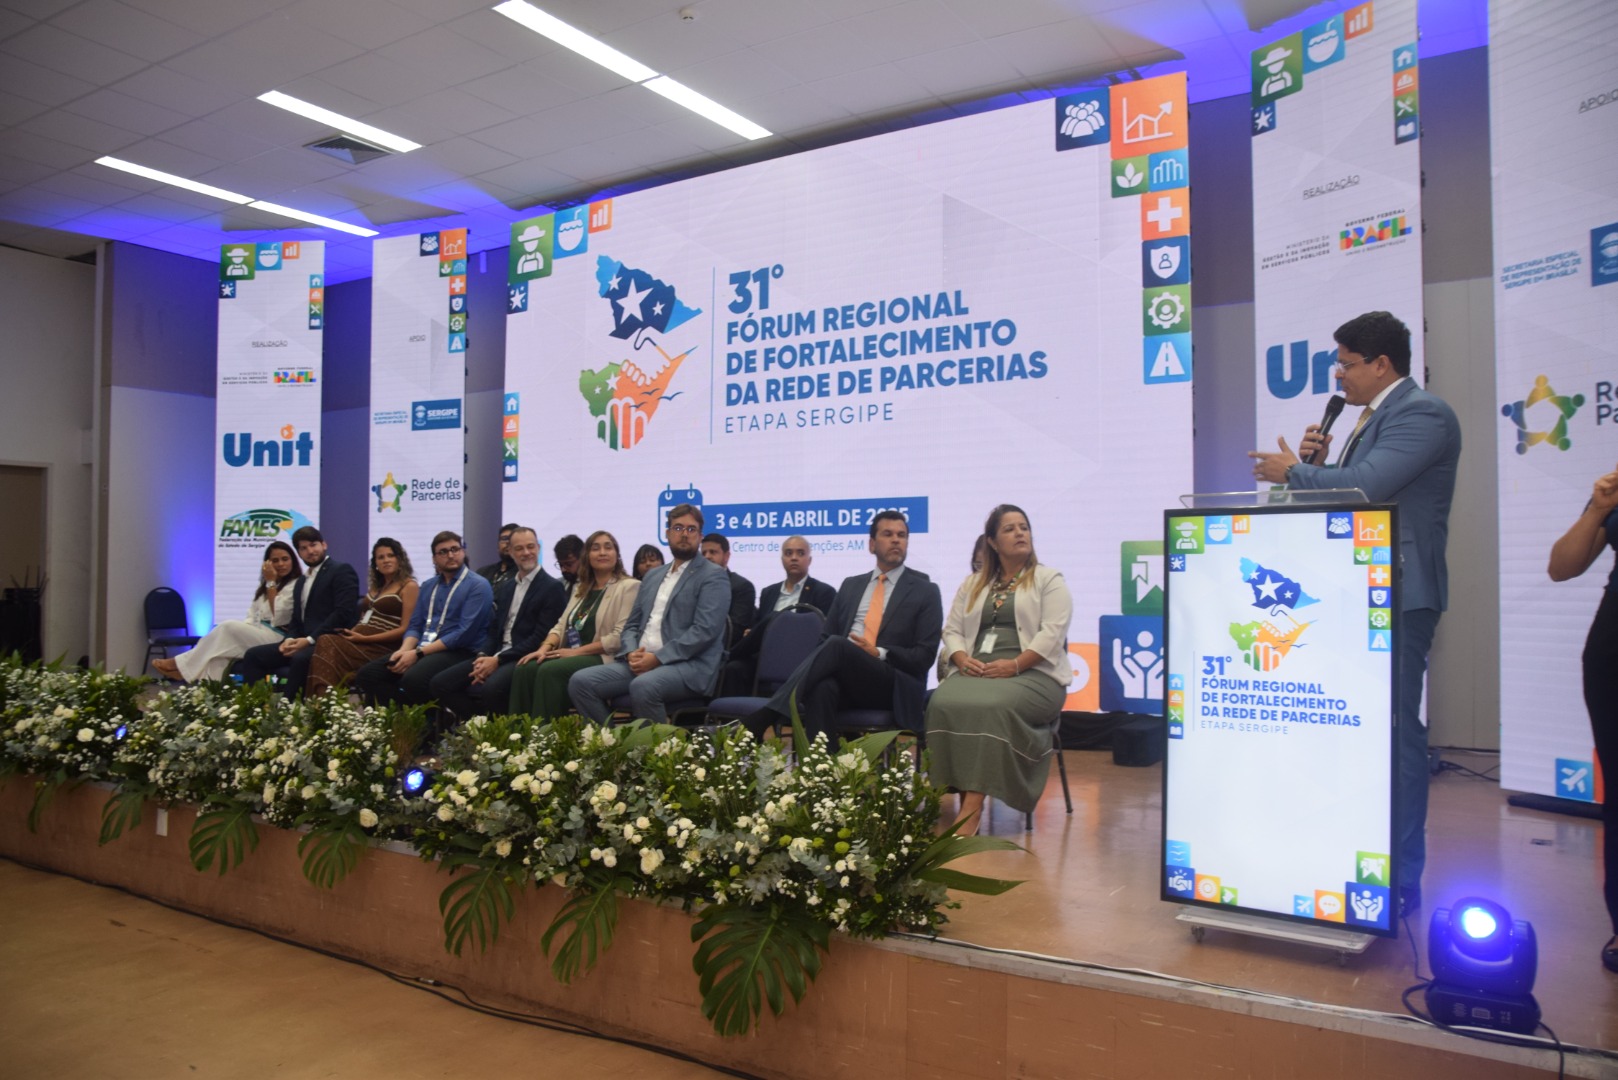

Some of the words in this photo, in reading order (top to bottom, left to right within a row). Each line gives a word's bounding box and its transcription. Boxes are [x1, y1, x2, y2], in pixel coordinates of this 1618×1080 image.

[1303, 175, 1361, 199] REALIZAÇÃO
[1339, 215, 1413, 251] BRASIL
[727, 310, 815, 345] FÓRUM
[823, 290, 969, 332] REGIONAL
[726, 350, 757, 375] DE
[763, 319, 1017, 371] FORTALECIMENTO
[273, 370, 317, 384] BRASIL
[726, 381, 759, 406] DA
[766, 373, 830, 402] REDE
[837, 368, 872, 396] DE
[880, 350, 1048, 392] PARCERIAS
[1266, 340, 1343, 400] Un
[427, 408, 459, 417] SERGIPE
[725, 412, 788, 433] ETAPA
[796, 402, 893, 428] SERGIPE
[223, 423, 313, 467] Unit
[412, 478, 441, 490] Rede
[445, 477, 460, 489] de
[412, 488, 461, 501] Parcerias
[220, 518, 280, 537] FAMES
[716, 513, 725, 530] 3
[728, 516, 739, 529] e
[742, 512, 753, 529] 4
[756, 511, 777, 529] DE
[781, 510, 832, 528] ABRIL
[838, 508, 861, 526] DE
[865, 507, 910, 526] 25
[732, 541, 764, 552] Centro
[767, 541, 779, 552] de
[847, 540, 865, 550] AM
[1202, 675, 1249, 691] FÓRUM
[1253, 680, 1325, 695] REGIONAL
[1201, 692, 1218, 703] DE
[1222, 693, 1347, 711] FORTALECIMENTO
[1201, 706, 1219, 717] DA
[1223, 707, 1256, 720] REDE
[1260, 709, 1278, 721] DE
[1281, 711, 1361, 727] PARCERIAS
[1201, 720, 1235, 731] ETAPA
[1239, 723, 1288, 735] SERGIPE
